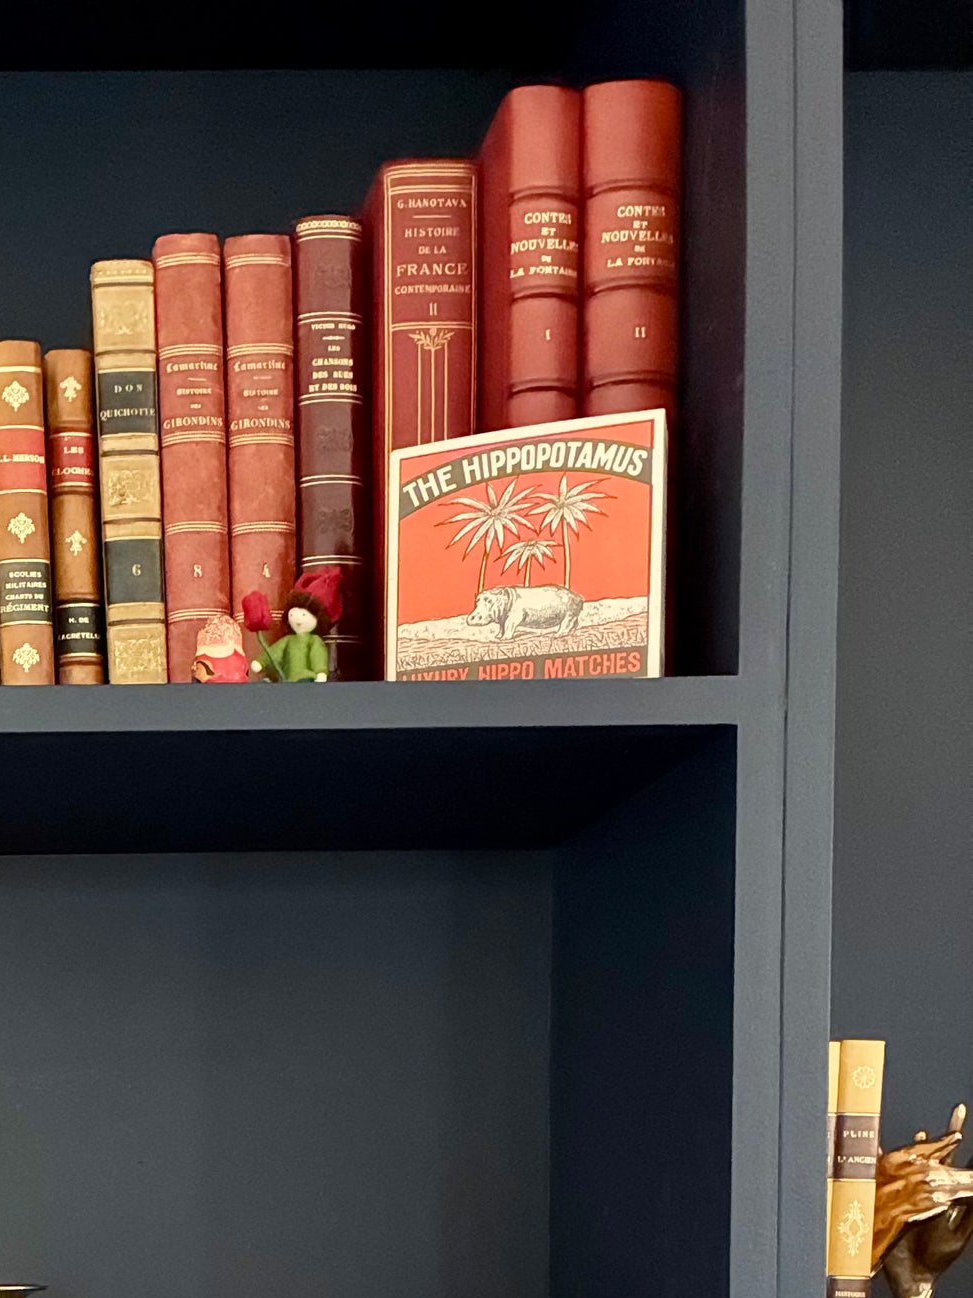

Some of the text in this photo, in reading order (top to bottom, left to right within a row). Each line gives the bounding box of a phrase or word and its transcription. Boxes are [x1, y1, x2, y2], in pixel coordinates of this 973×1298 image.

[633, 220, 648, 229] ET
[404, 227, 461, 238] HISTOIRE
[541, 227, 557, 236] ET
[418, 246, 447, 255] DE LA
[607, 258, 623, 268] LA
[396, 263, 468, 277] FRANCE
[510, 268, 525, 278] LA
[394, 284, 472, 295] CONTEMPORAINE
[635, 327, 646, 338] II
[312, 371, 328, 380] DES
[176, 388, 212, 396] HISTOIRE
[308, 384, 320, 392] ET
[322, 383, 338, 391] DES
[99, 408, 156, 421] QUICHOTTE
[163, 416, 223, 430] GIRONDINS
[230, 417, 291, 431] GIRONDINS
[403, 441, 648, 508] THE HIPPOPOTAMUS
[132, 563, 142, 577] 6
[5, 581, 47, 589] MILITAIRES
[0, 602, 50, 614] RÉGIMENT
[478, 652, 641, 680] HIPPO MATCHES
[843, 1130, 876, 1139] PLINE
